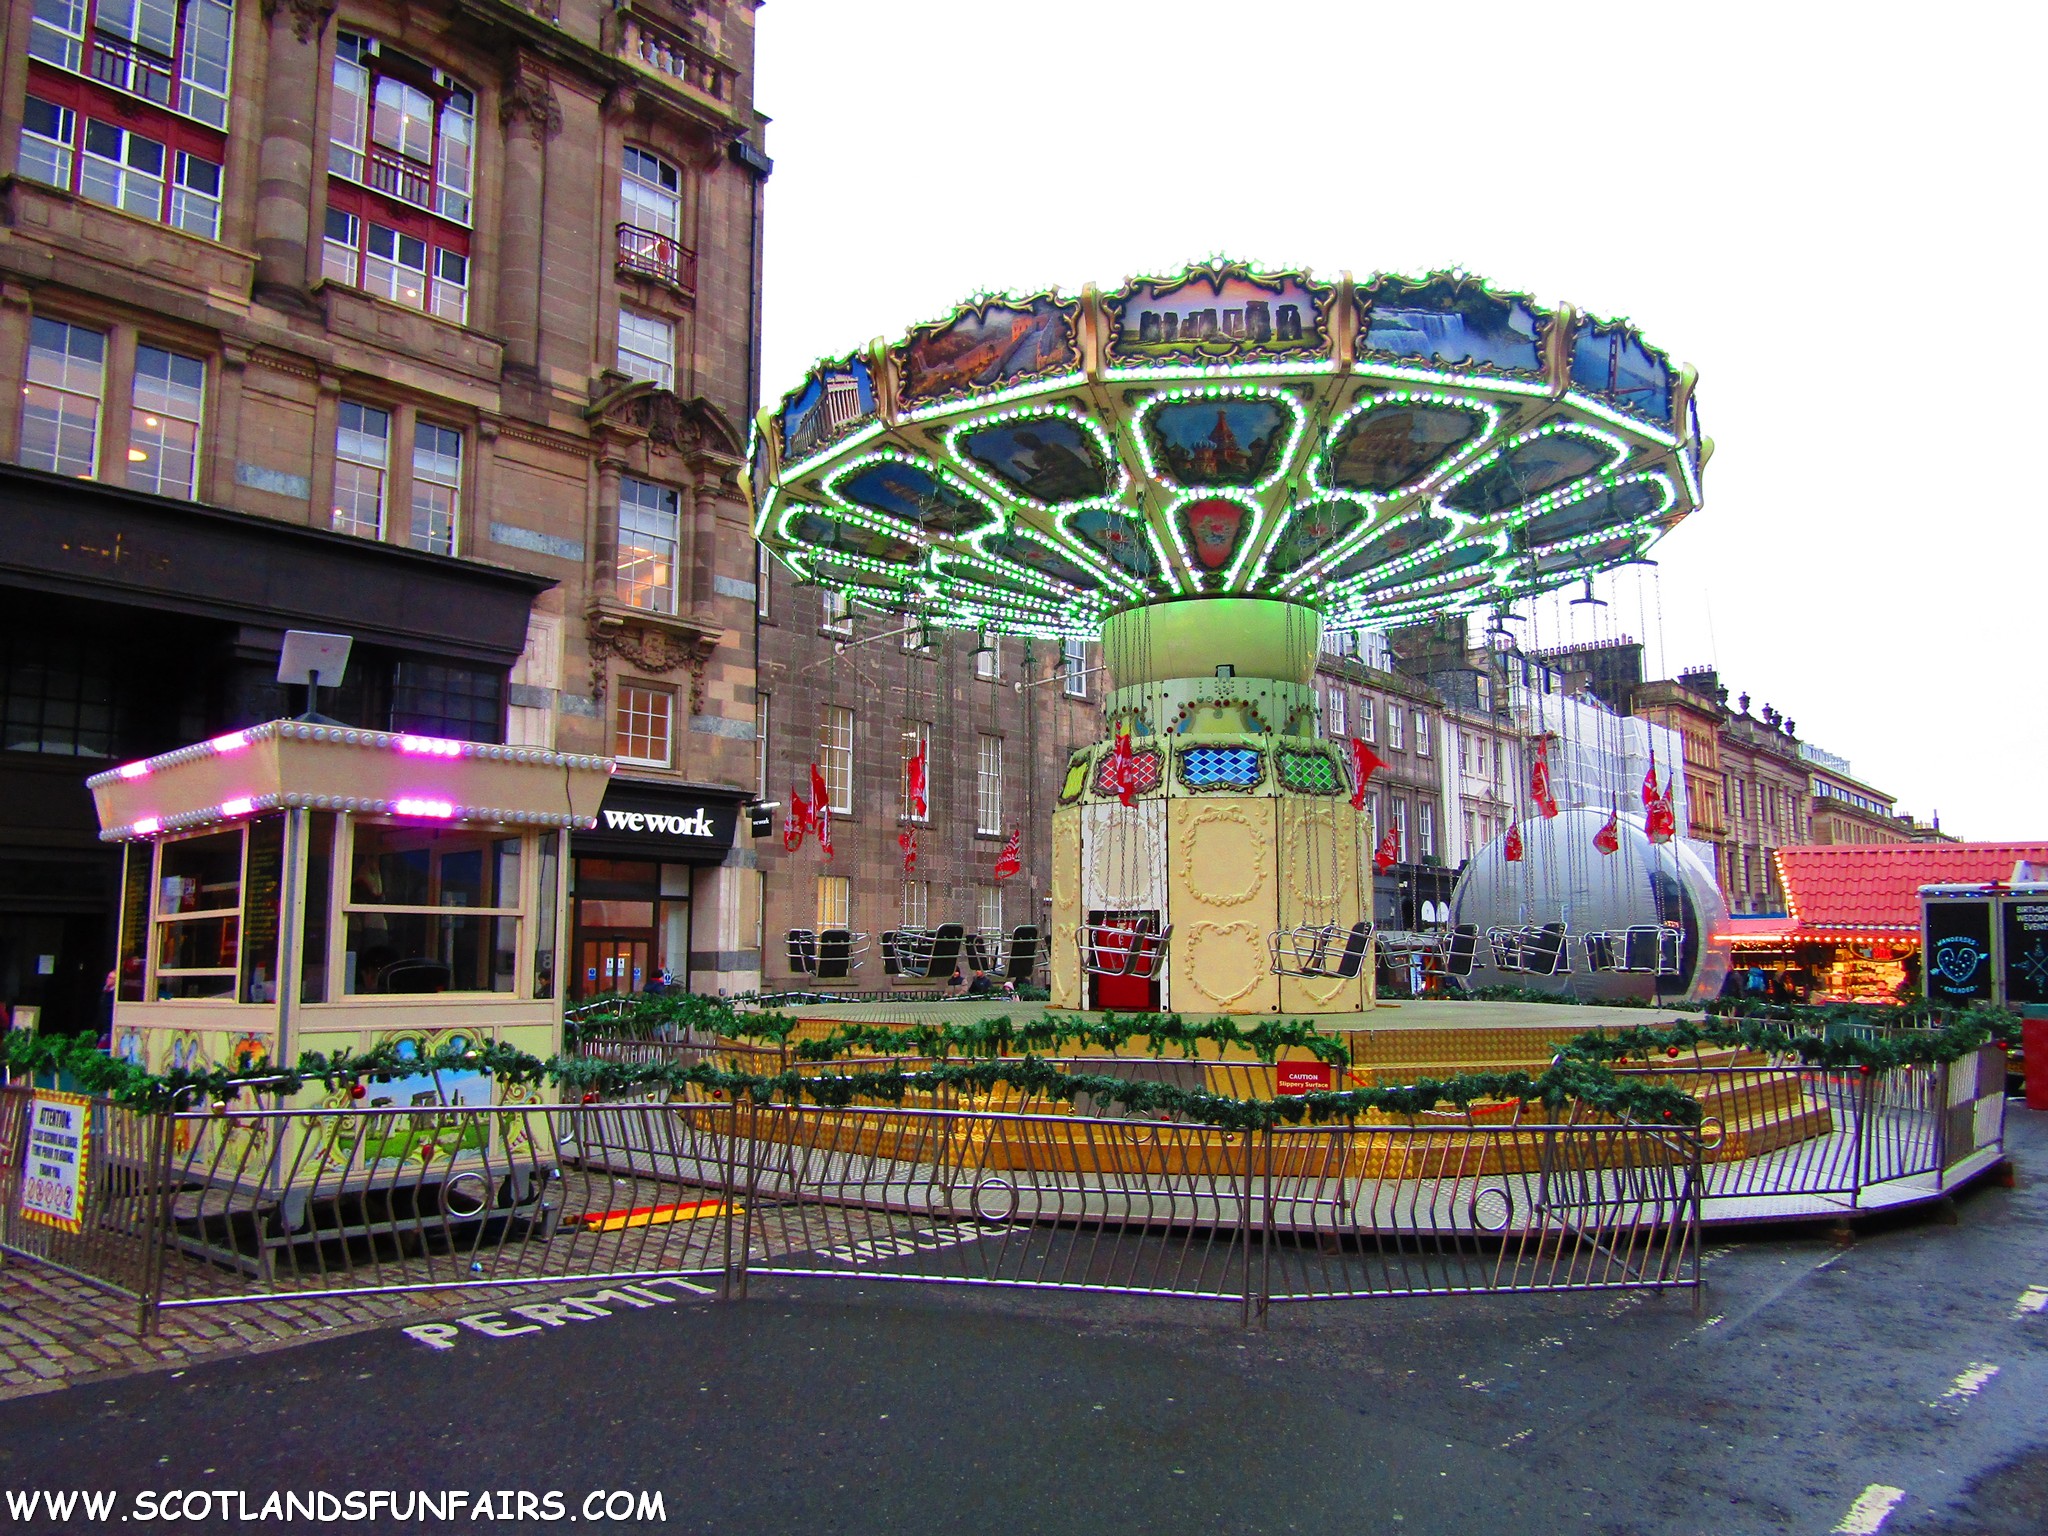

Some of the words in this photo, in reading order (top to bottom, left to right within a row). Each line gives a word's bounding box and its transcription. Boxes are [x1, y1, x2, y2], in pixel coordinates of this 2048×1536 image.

[603, 807, 714, 837] wework
[1279, 1080, 1304, 1088] Slippery
[402, 1277, 717, 1350] PERMIT
